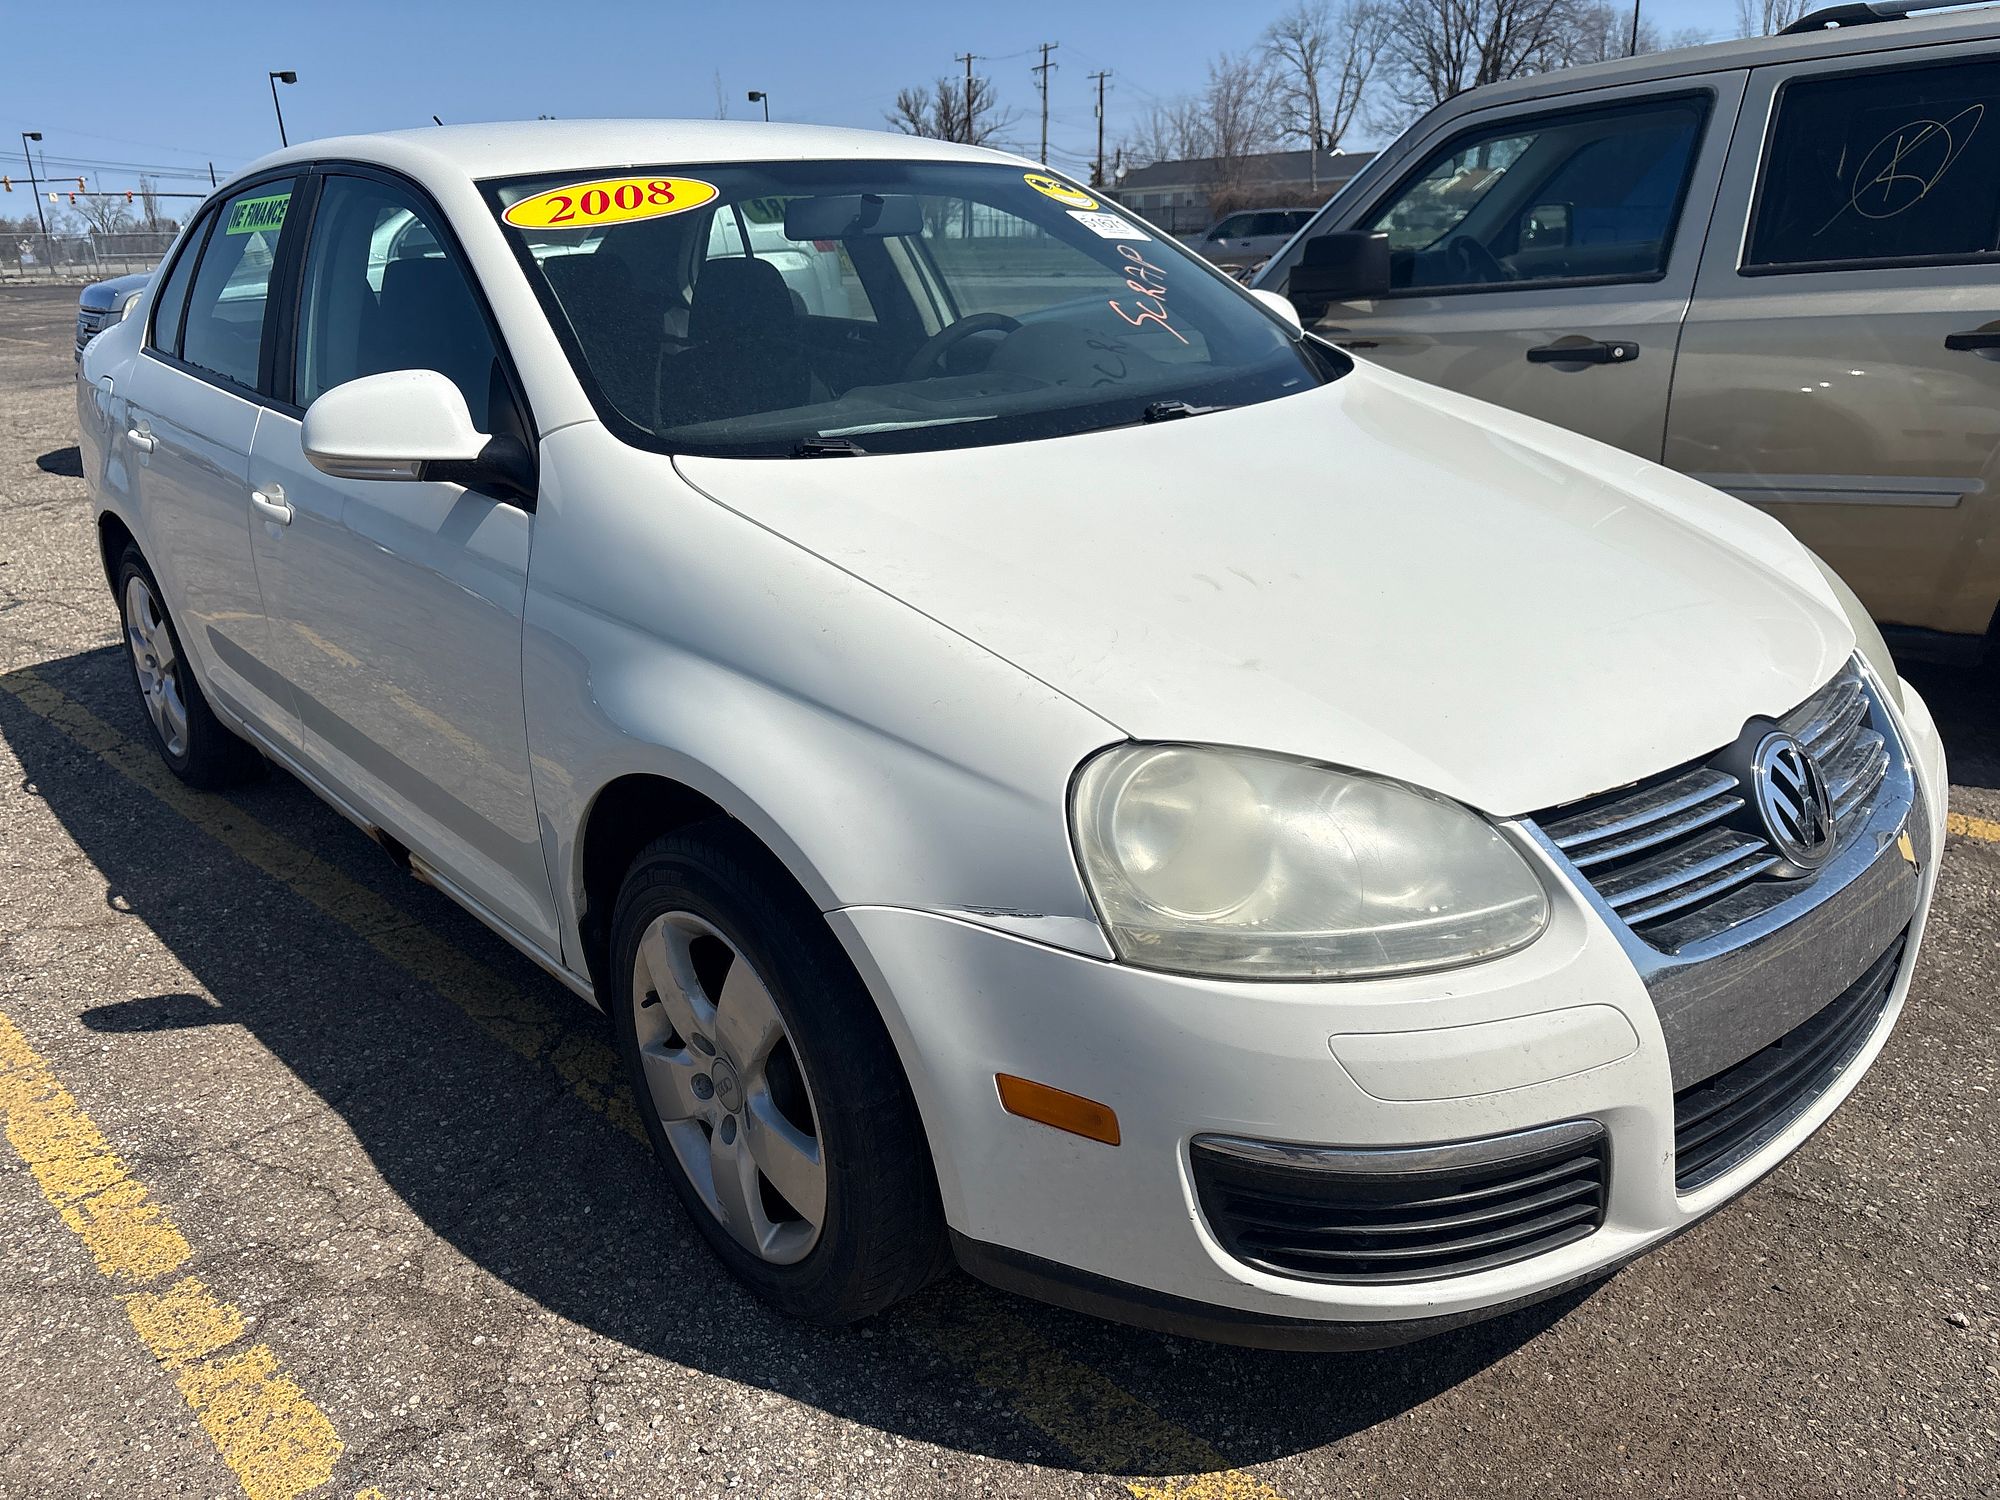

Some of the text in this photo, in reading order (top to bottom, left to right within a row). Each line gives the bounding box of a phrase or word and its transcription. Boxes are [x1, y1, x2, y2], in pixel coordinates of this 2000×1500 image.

[230, 199, 289, 228] WE FINANCE
[545, 181, 675, 224] 2008
